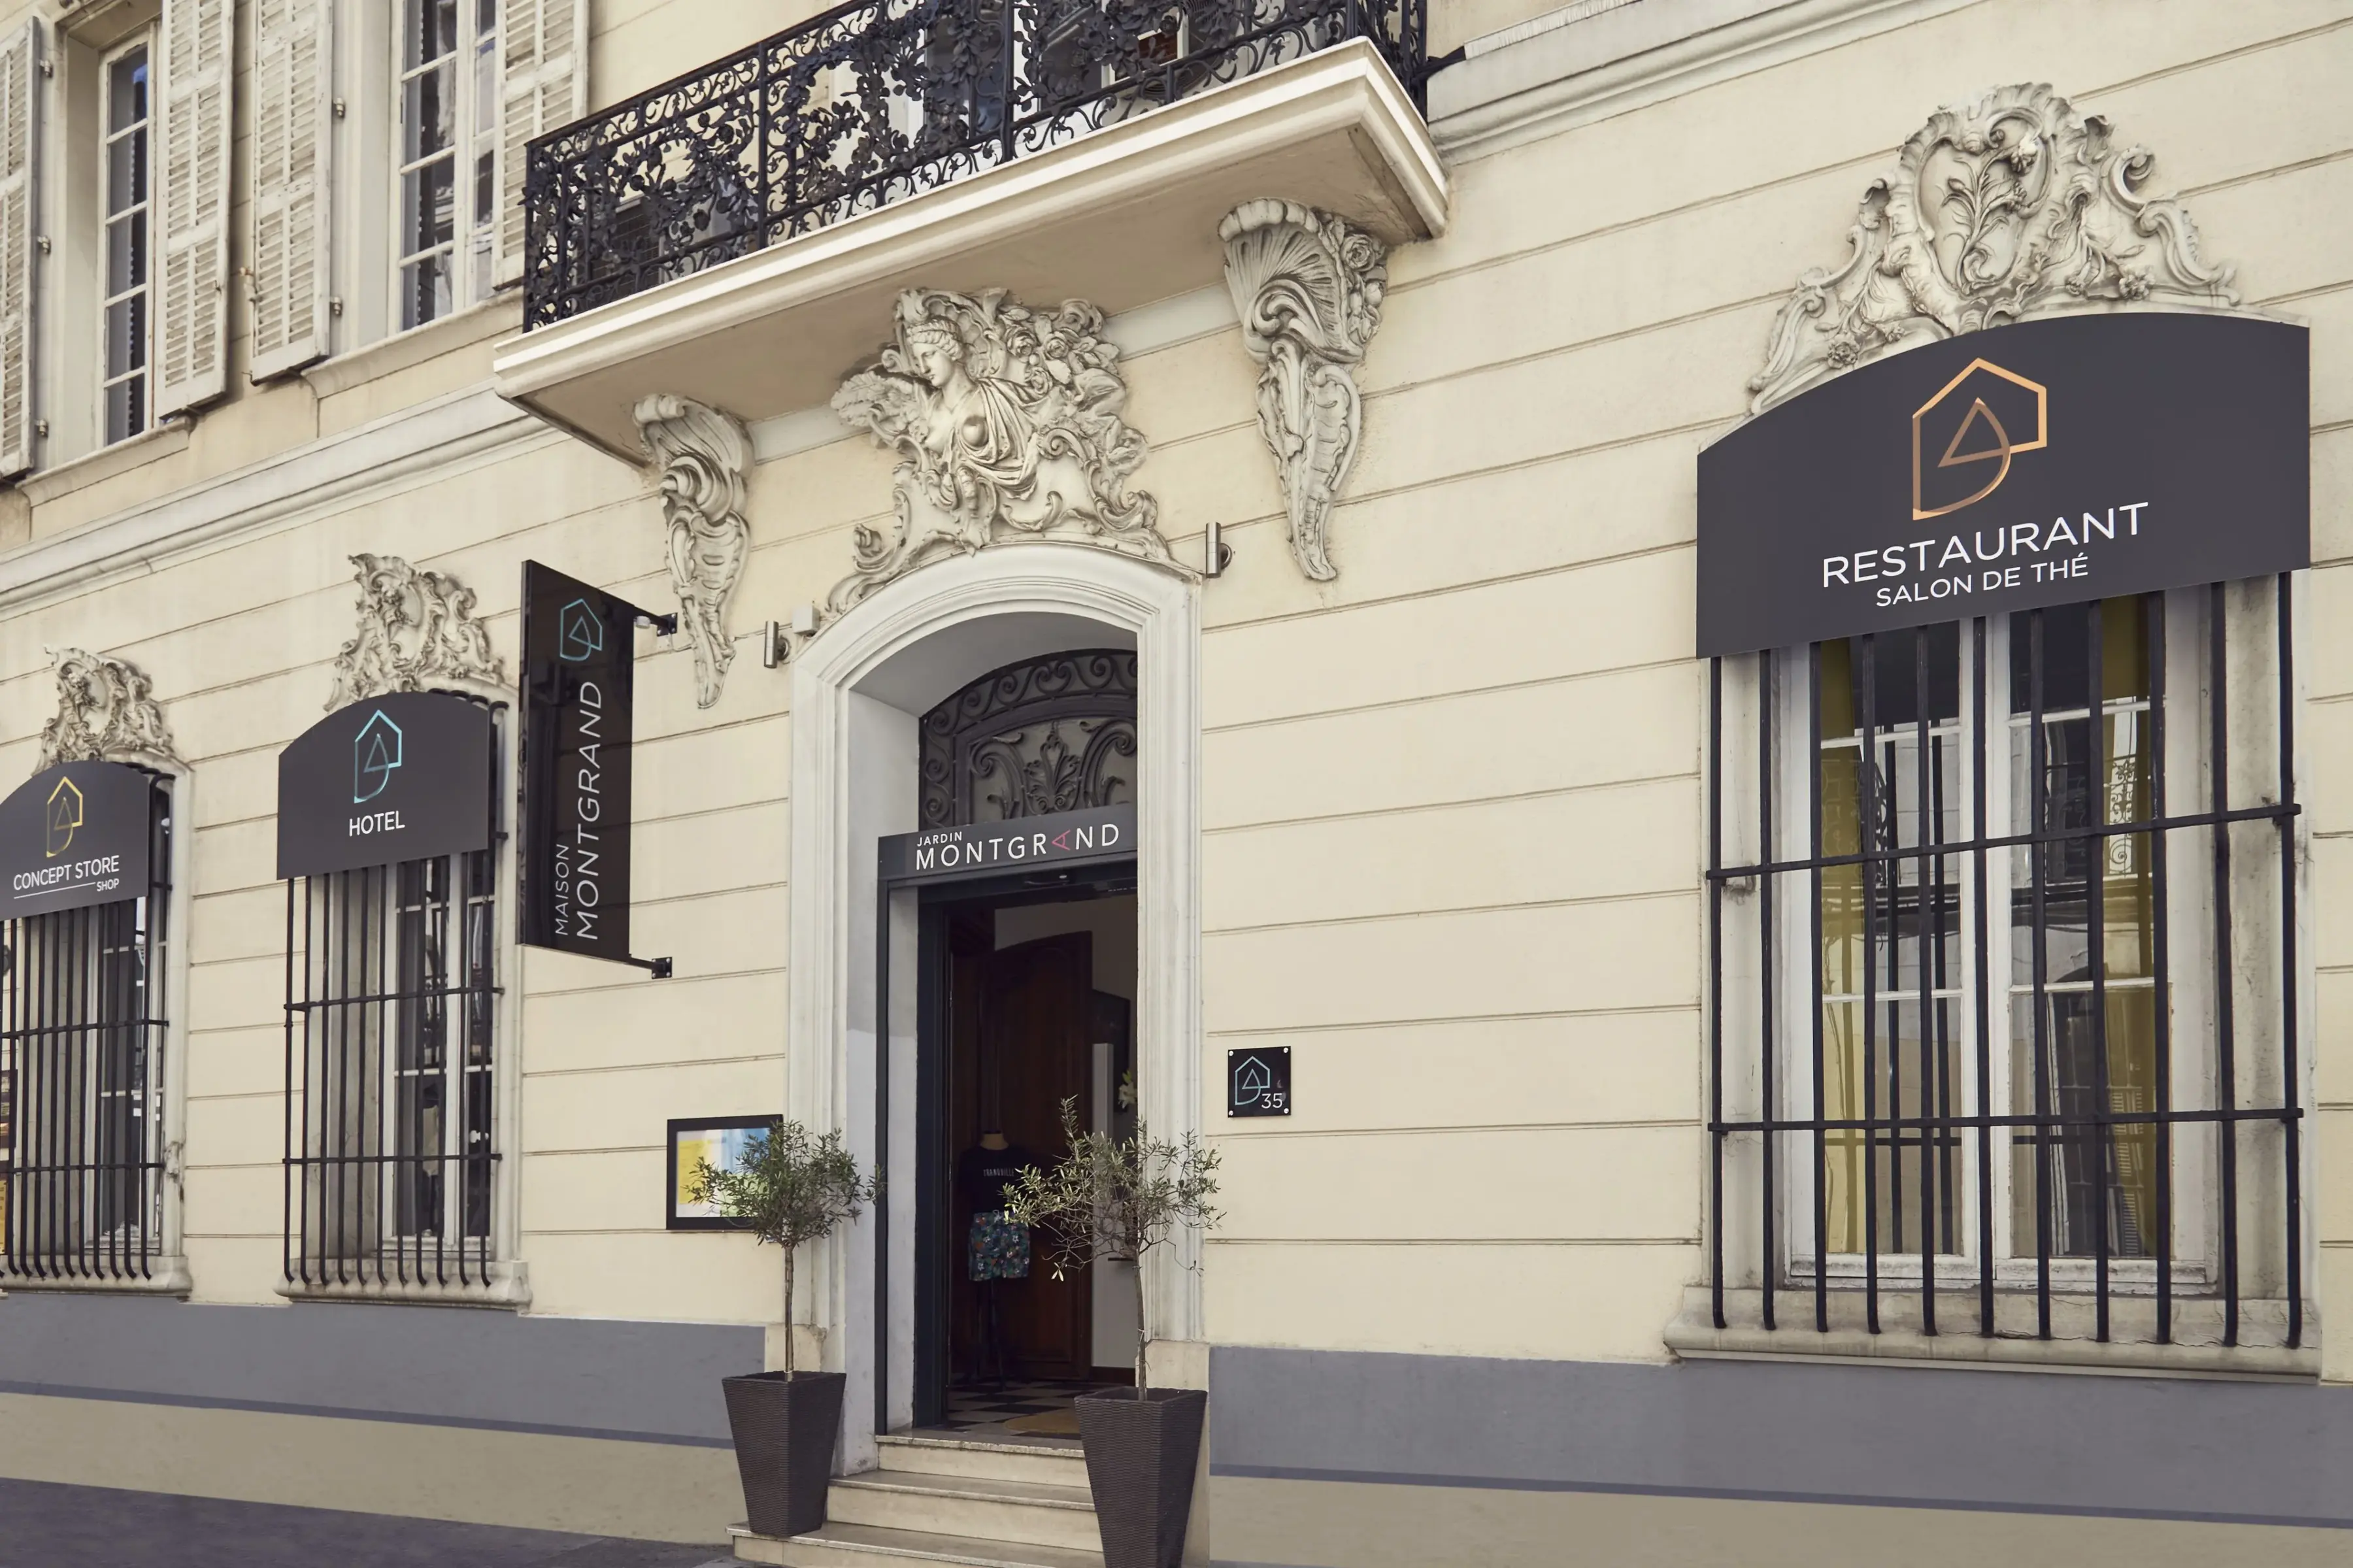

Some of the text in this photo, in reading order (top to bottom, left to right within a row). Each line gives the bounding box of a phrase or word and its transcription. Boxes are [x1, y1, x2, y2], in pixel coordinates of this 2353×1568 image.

[1823, 501, 2149, 588] RESTAURANT
[1876, 552, 2089, 607] SALON DE THÉ
[348, 810, 406, 837] HOTEL
[576, 681, 601, 940] MONTGRAND
[916, 831, 963, 847] JARDIN
[916, 824, 1120, 871] MONTGRAND
[13, 854, 120, 891] CONCEPT STORE
[96, 878, 120, 892] SHOP
[555, 844, 570, 935] MAISON
[1261, 1092, 1283, 1109] 35
